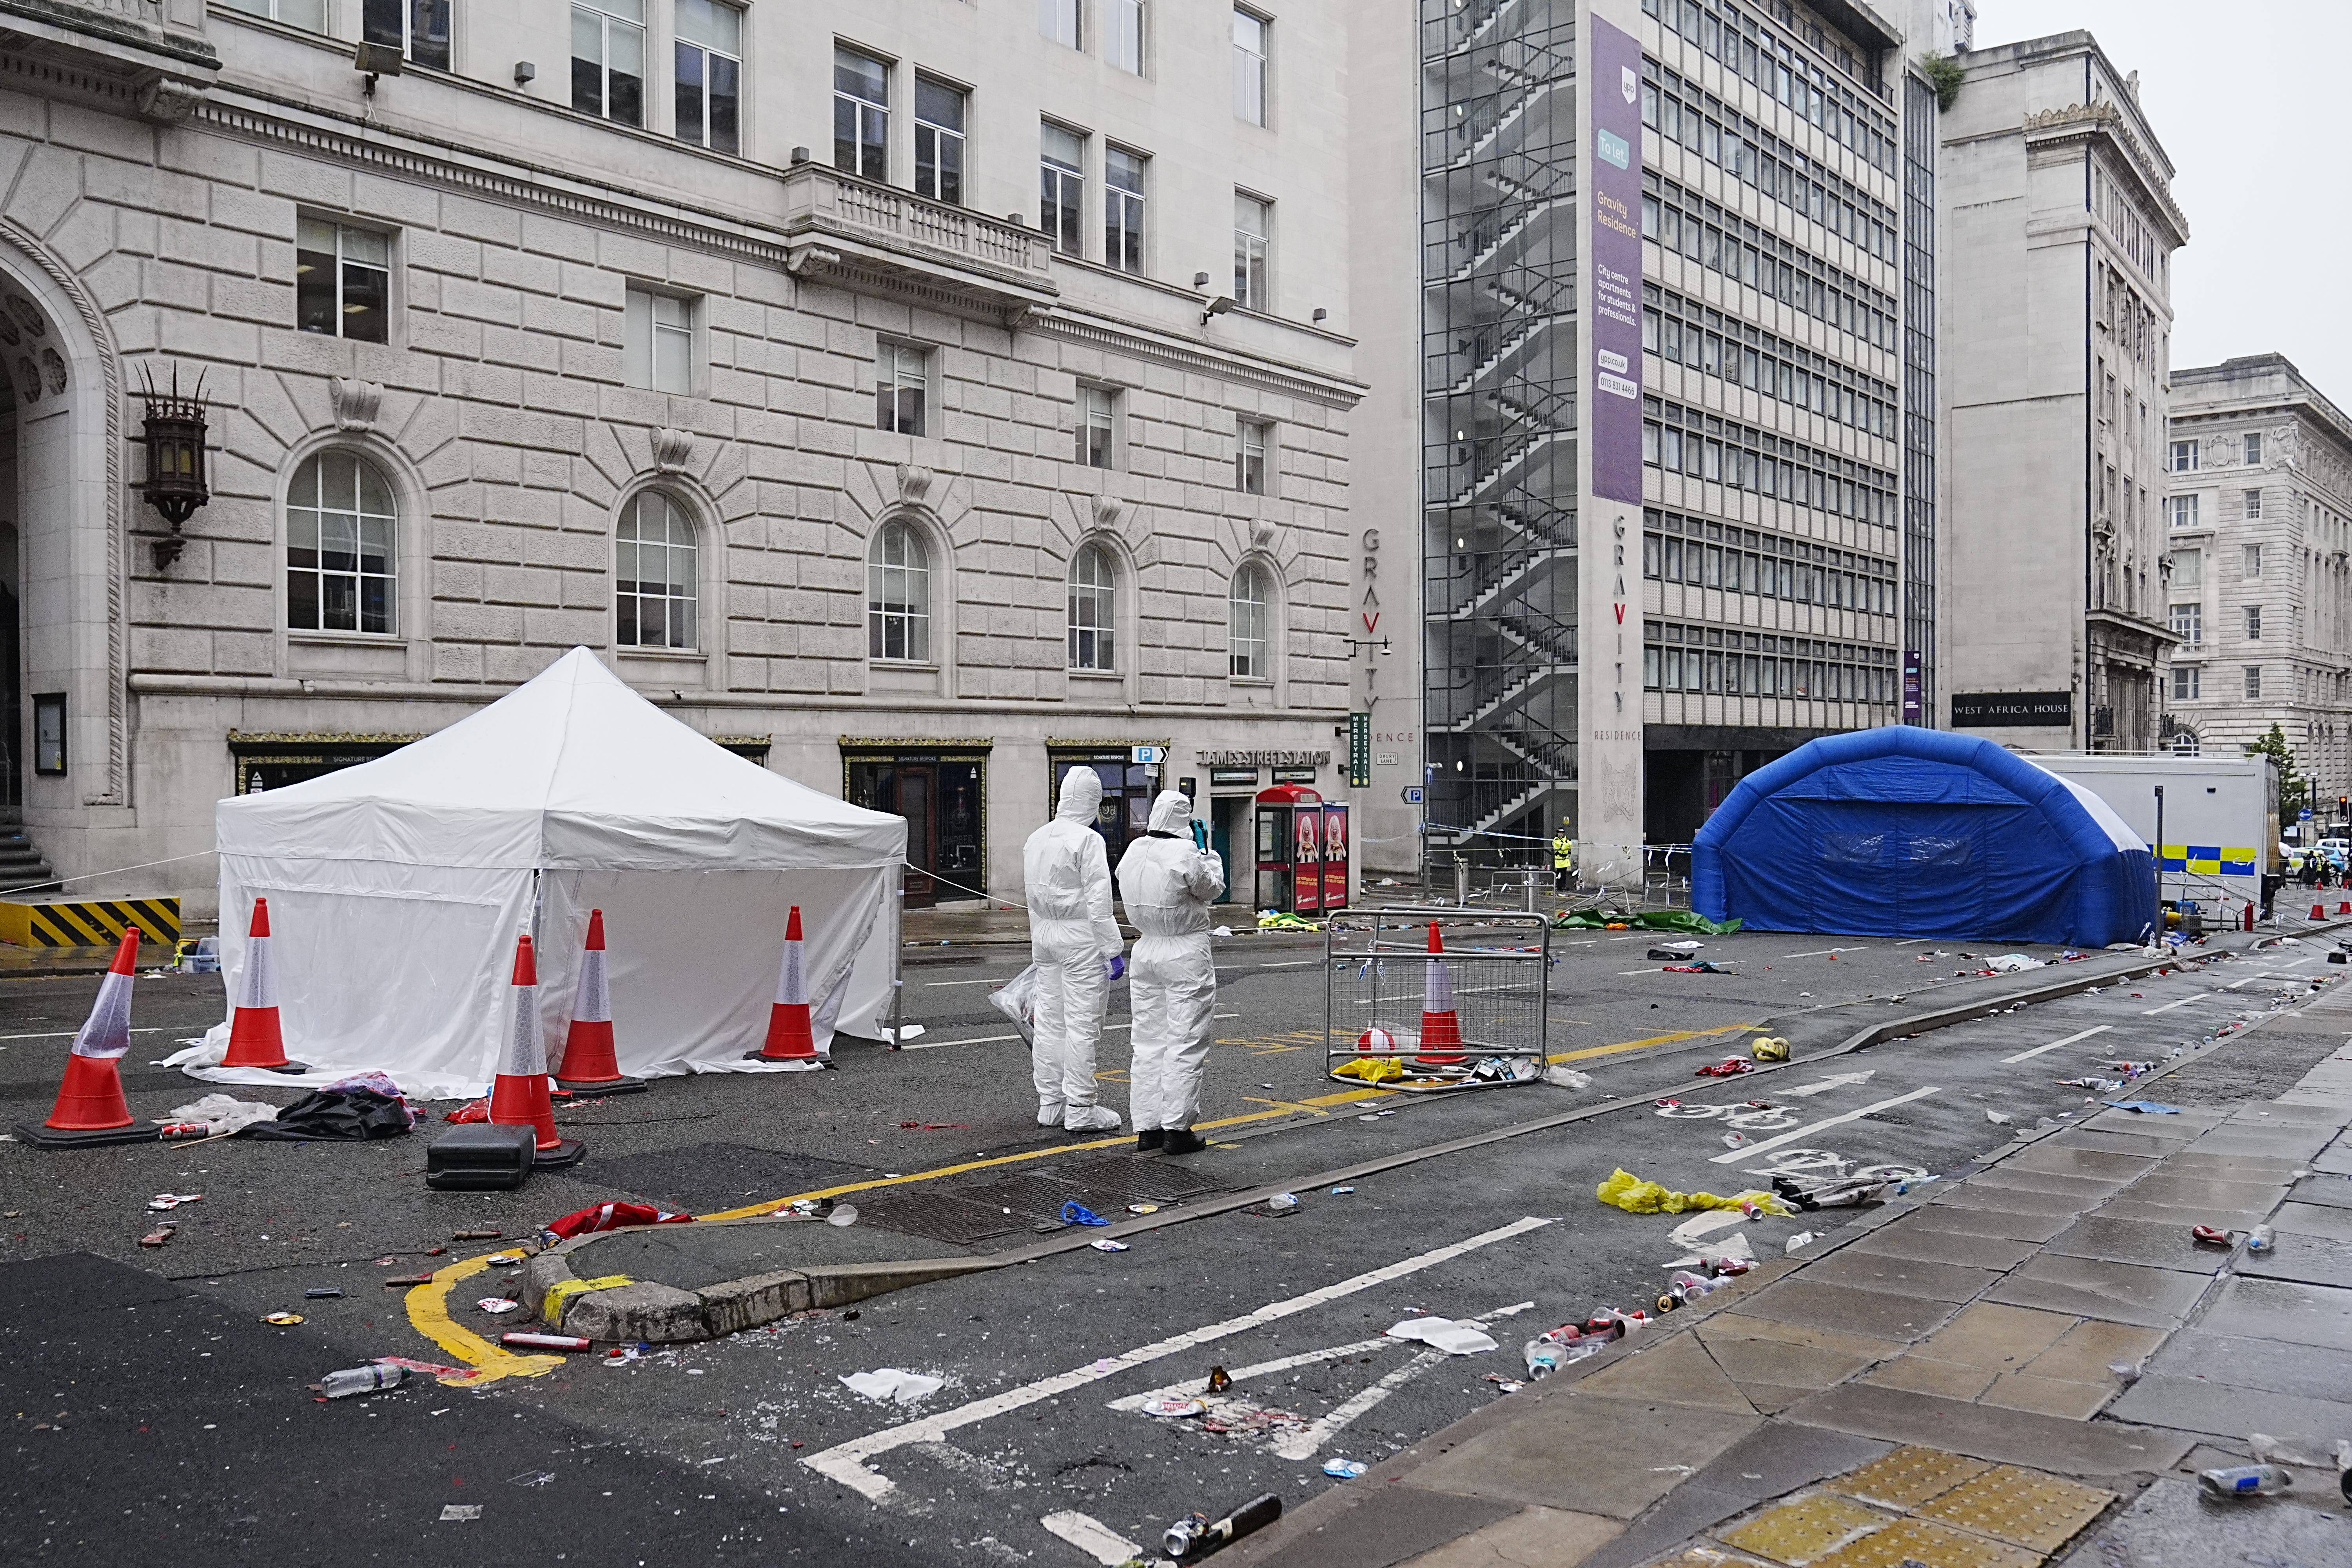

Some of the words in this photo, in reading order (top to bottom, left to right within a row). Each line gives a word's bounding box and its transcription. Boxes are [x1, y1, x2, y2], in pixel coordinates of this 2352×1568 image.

[1624, 81, 1634, 95] ypp
[1600, 136, 1610, 154] To
[1613, 143, 1626, 163] let.
[1598, 191, 1627, 219] Gravity
[1598, 209, 1636, 238] Residence
[1598, 264, 1610, 279] City
[1611, 271, 1628, 285] centre
[1598, 279, 1631, 299] apartments
[1598, 290, 1607, 303] for
[1607, 294, 1631, 312] students
[1632, 303, 1636, 313] &
[1598, 305, 1636, 327] professionals.
[1601, 354, 1625, 368] ypp.co.uk
[1601, 376, 1611, 388] 0113
[1612, 379, 1621, 391] 831
[1621, 383, 1634, 395] 4466
[1613, 515, 1625, 713] GRAVITY
[2034, 704, 2068, 713] HOUSE
[1595, 731, 1641, 740] RESIDENCE
[1142, 750, 1150, 760] P
[1196, 750, 1243, 764] JAMES
[1244, 750, 1284, 764] STREET
[1283, 750, 1330, 764] STATION
[1413, 791, 1420, 800] P
